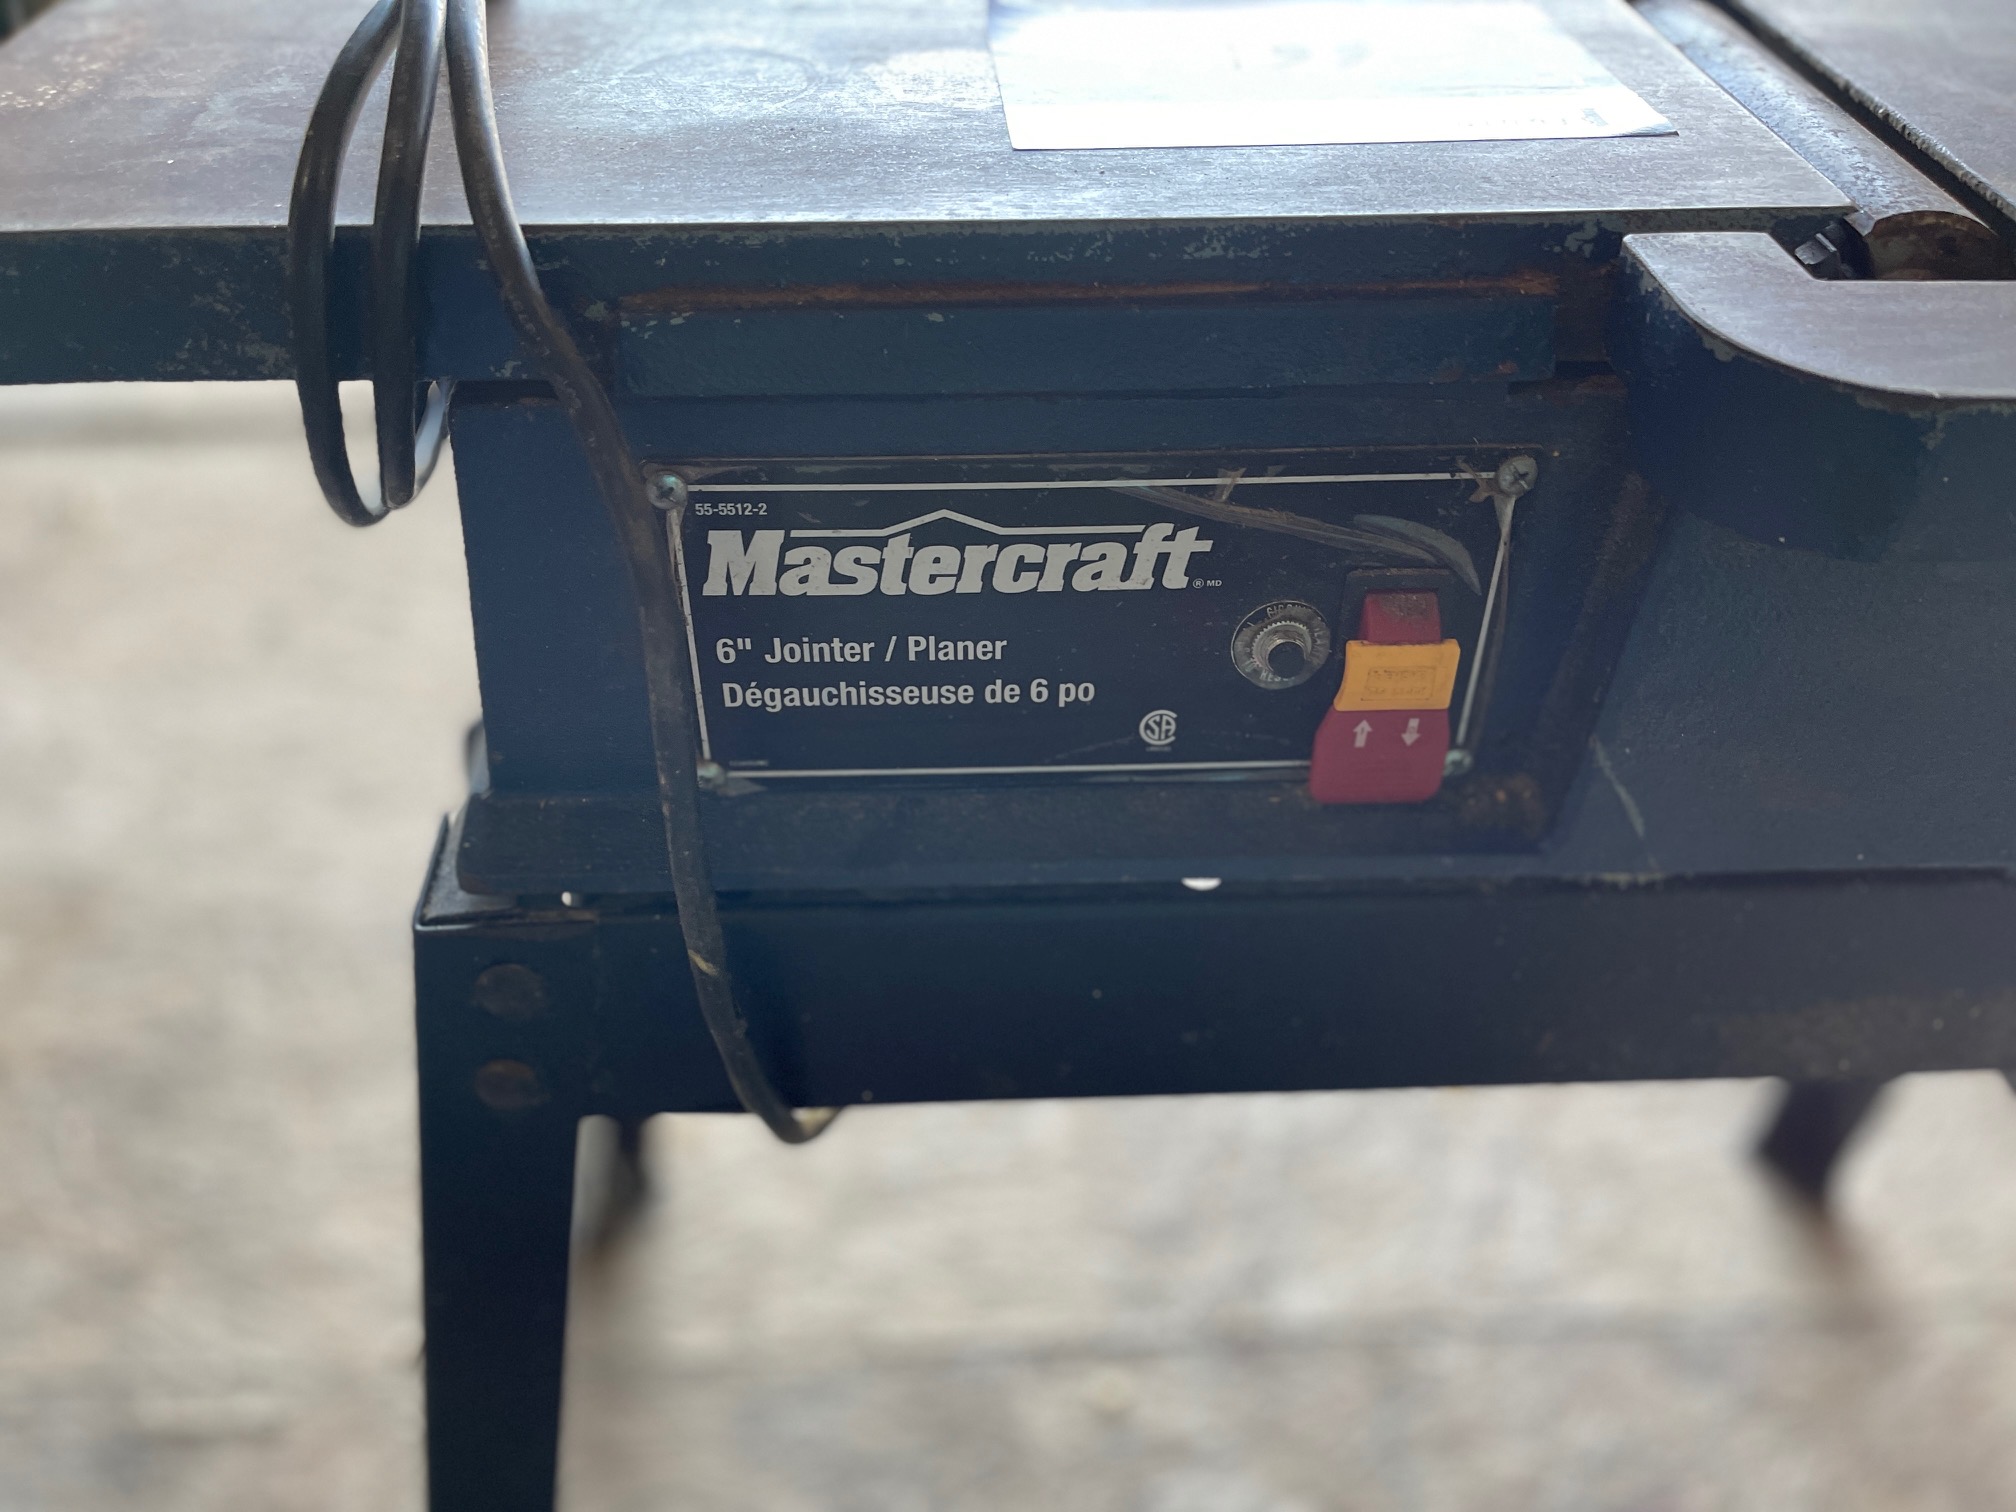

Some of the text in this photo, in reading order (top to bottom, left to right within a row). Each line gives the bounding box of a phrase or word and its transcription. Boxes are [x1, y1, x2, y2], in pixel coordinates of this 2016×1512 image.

[694, 503, 768, 516] 55-5512-2
[702, 522, 1213, 596] Mastercraft
[715, 634, 1007, 664] 6" Jointer / Planer
[722, 678, 1096, 713] Dégauchisseuse de 6 po
